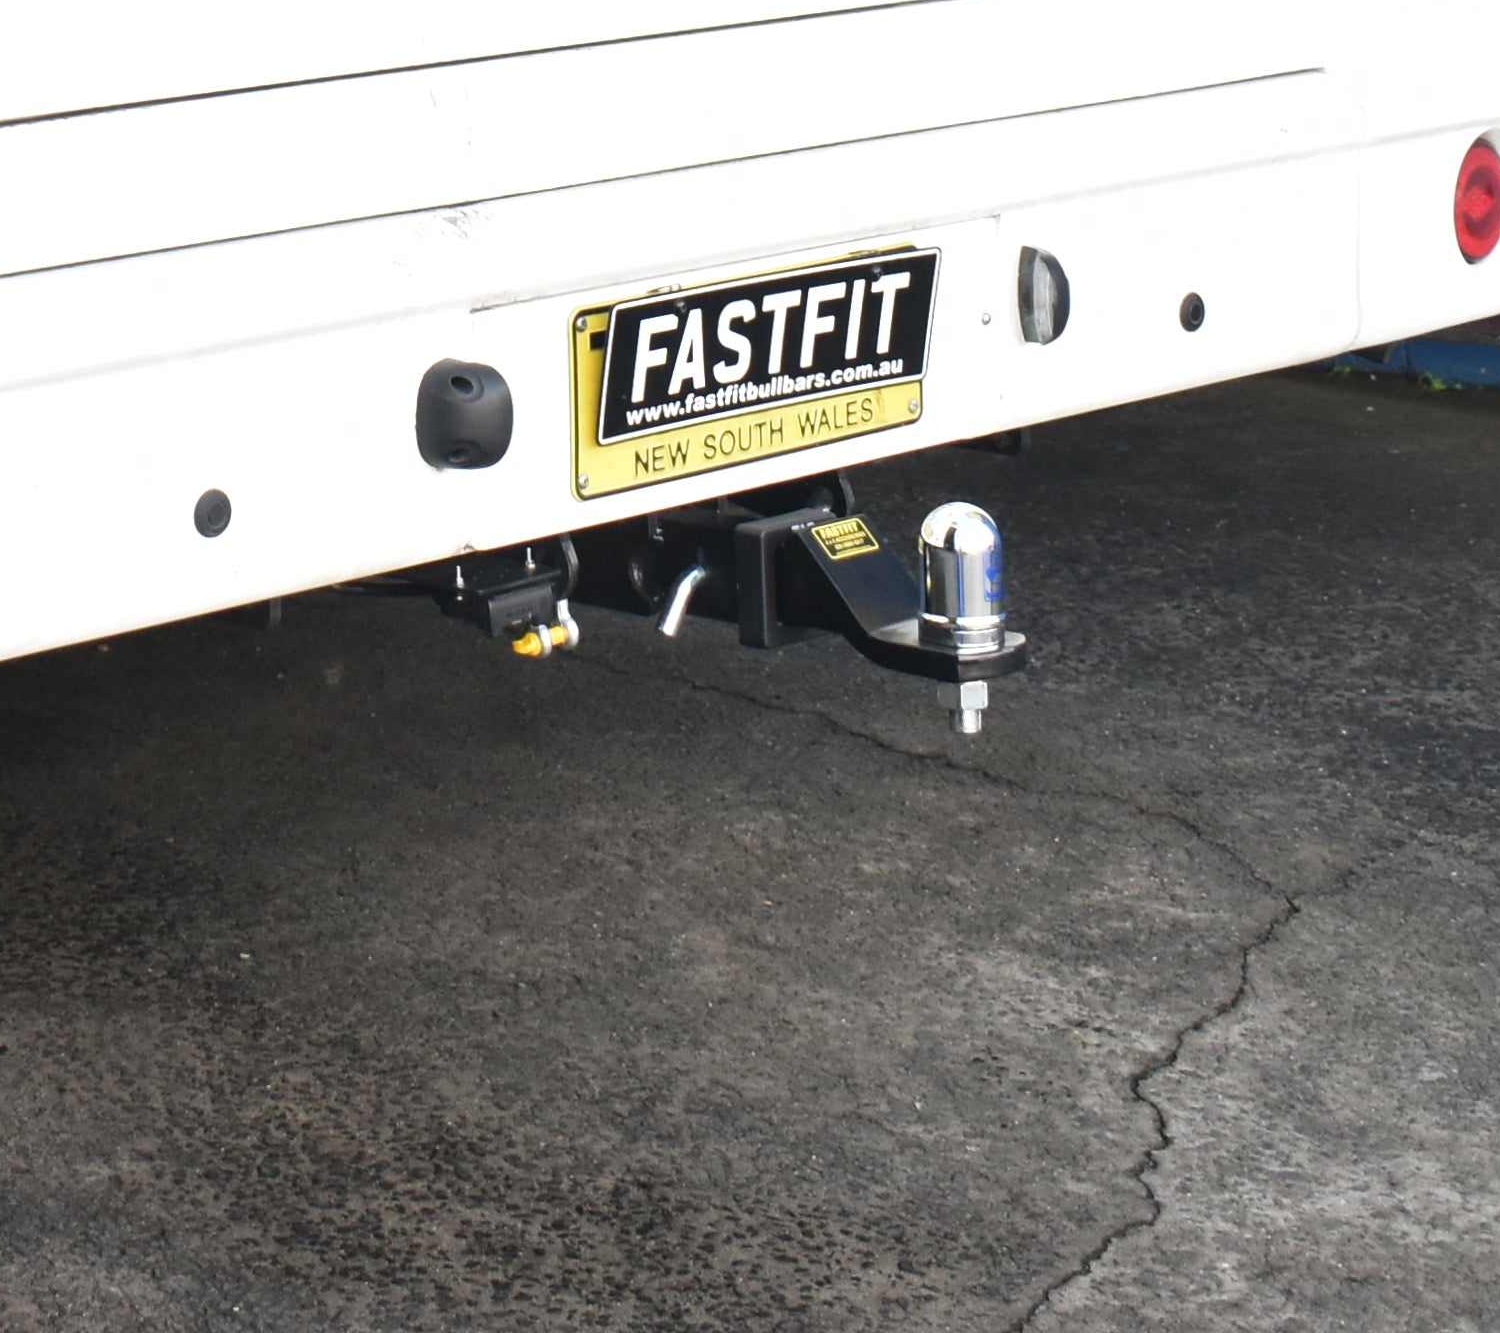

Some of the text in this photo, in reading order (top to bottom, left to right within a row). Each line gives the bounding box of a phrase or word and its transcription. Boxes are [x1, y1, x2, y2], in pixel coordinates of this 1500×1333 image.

[631, 271, 911, 404] FASTFIT
[626, 359, 903, 426] www.fastfitbullbars.com.au
[634, 397, 875, 476] NEW SOUTH WALES
